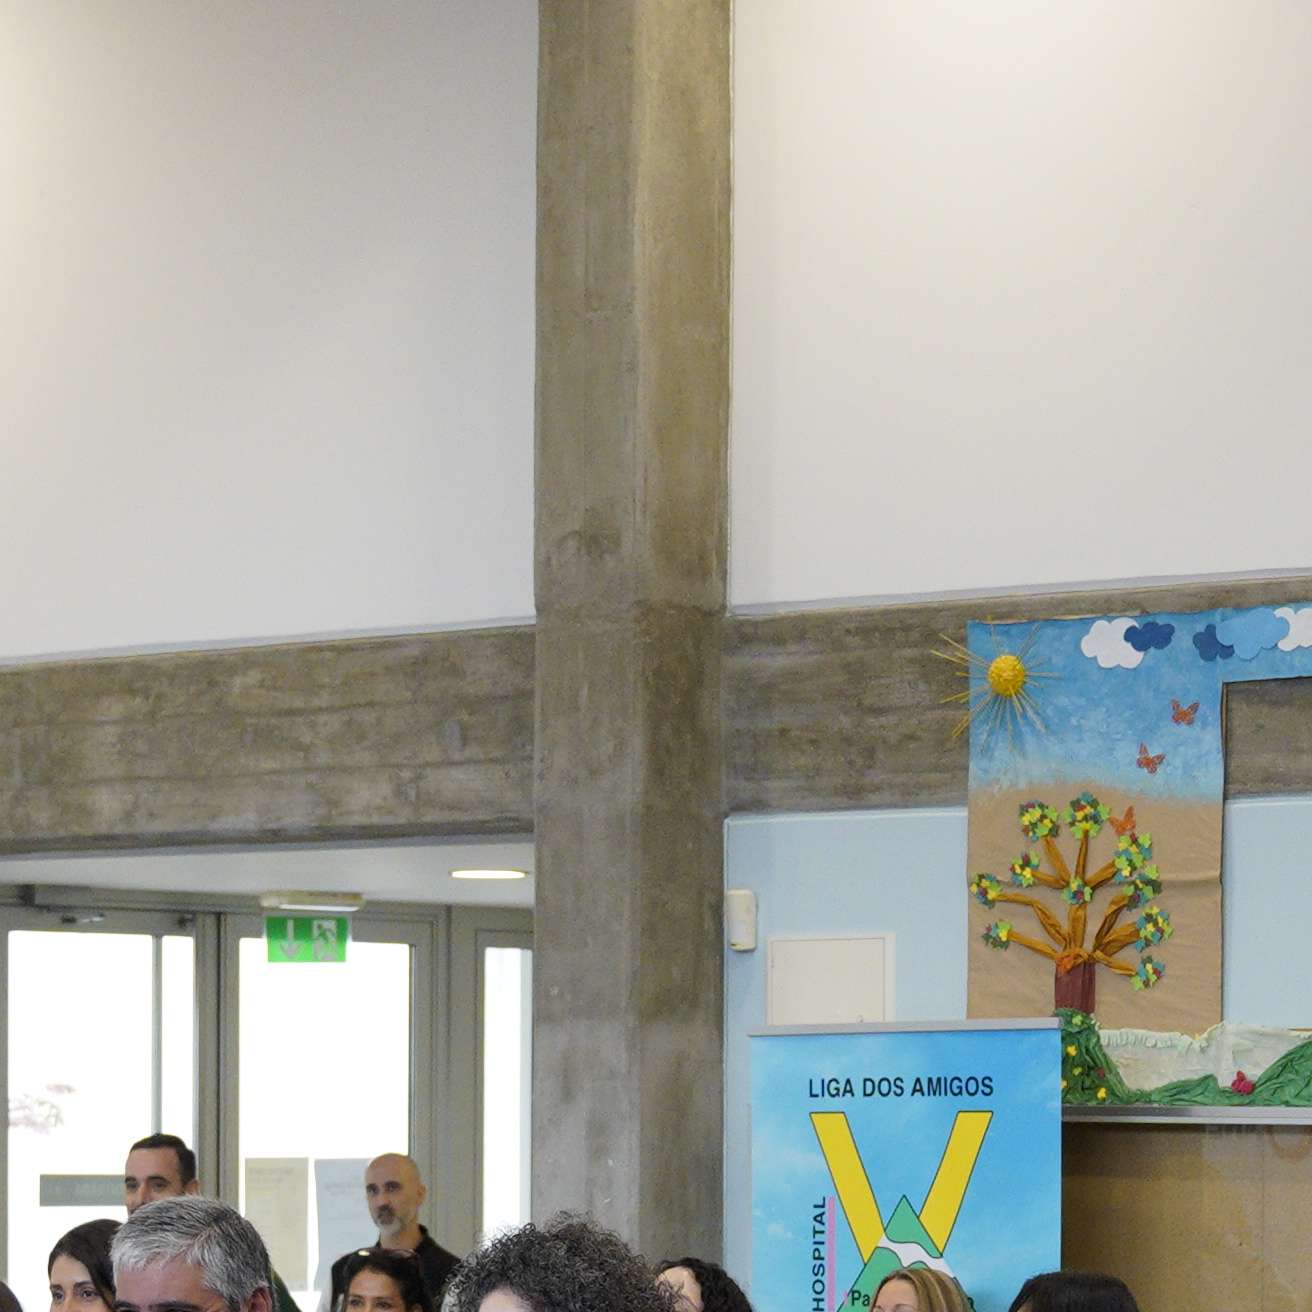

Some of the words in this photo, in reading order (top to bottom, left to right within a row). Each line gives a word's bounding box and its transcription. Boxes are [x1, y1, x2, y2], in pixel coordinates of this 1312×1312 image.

[809, 1078, 855, 1098] LIGA
[863, 1077, 904, 1097] DOS
[911, 1076, 994, 1097] AMIGOS
[812, 1196, 827, 1312] HOSPITAL
